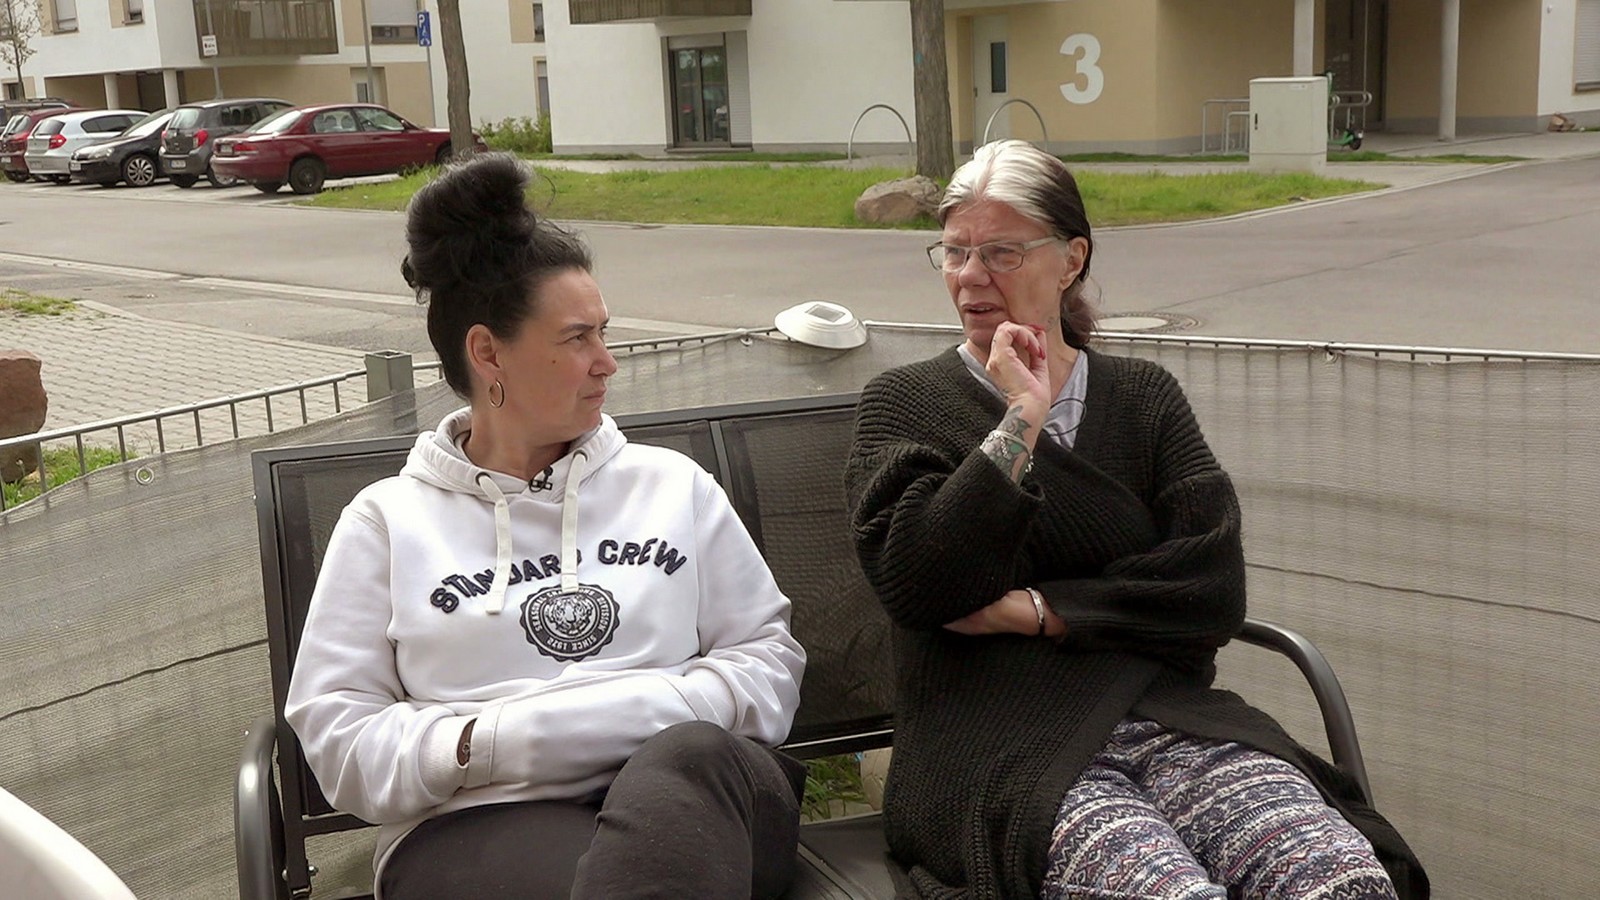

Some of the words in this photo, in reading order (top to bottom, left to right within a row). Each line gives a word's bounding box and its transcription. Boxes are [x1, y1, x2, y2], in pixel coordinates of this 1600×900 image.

[418, 14, 426, 28] P
[1060, 33, 1104, 105] 3
[598, 538, 687, 576] CREW
[572, 634, 597, 650] SINCE
